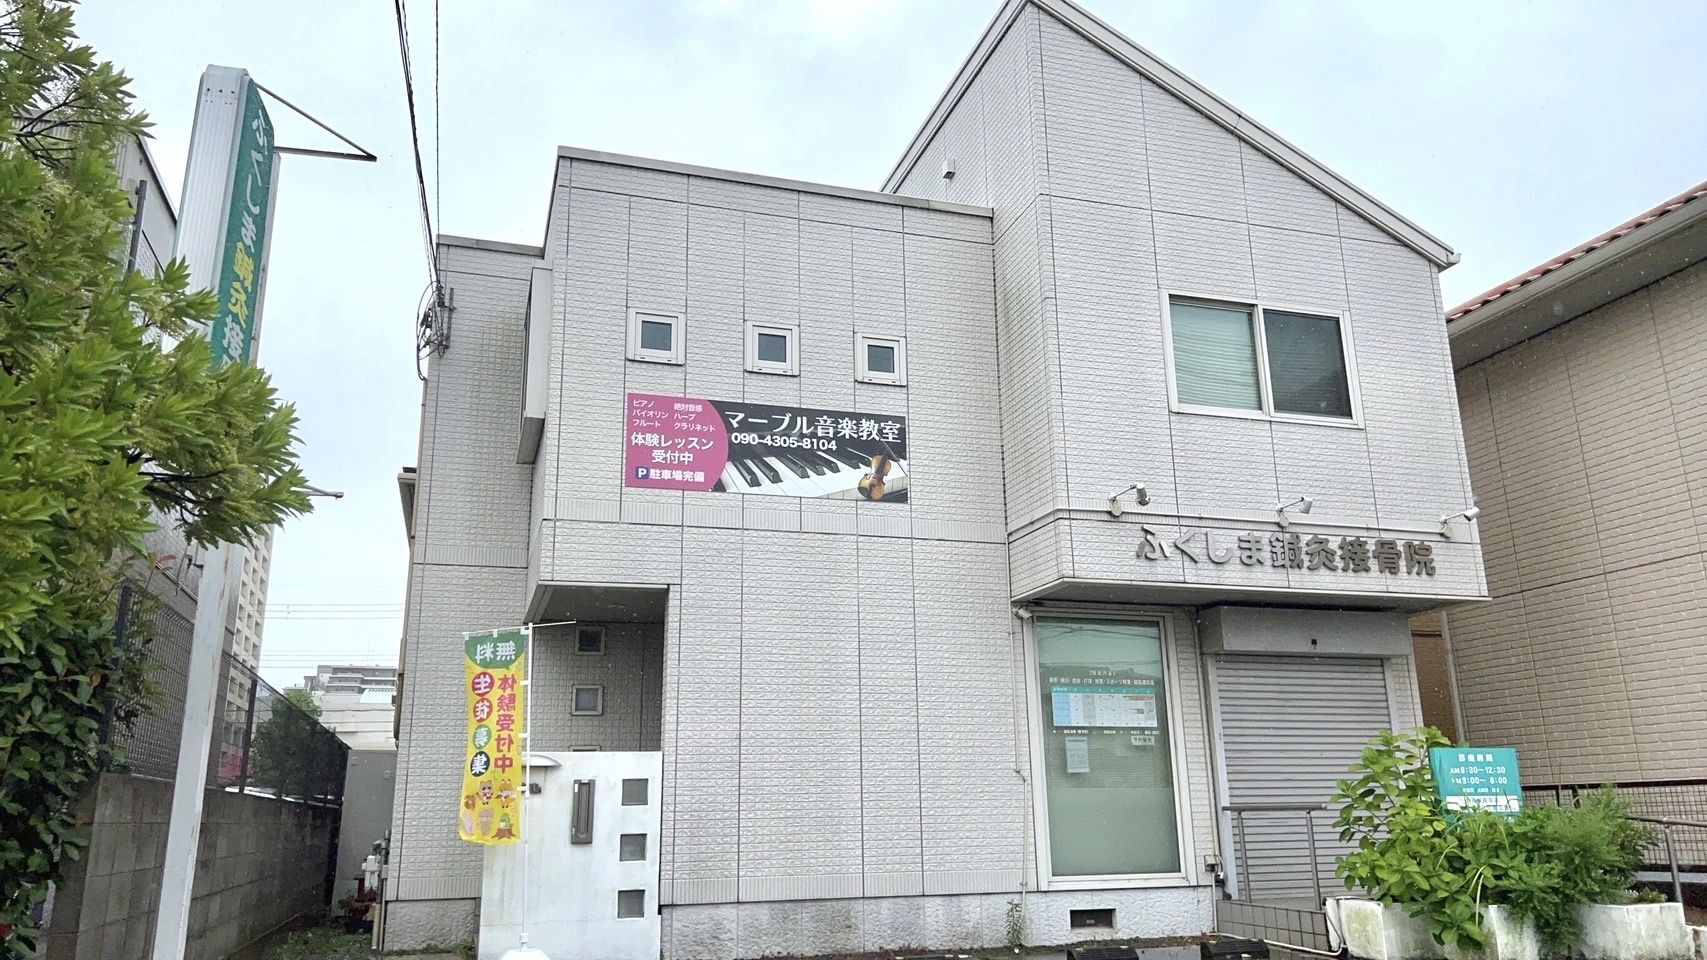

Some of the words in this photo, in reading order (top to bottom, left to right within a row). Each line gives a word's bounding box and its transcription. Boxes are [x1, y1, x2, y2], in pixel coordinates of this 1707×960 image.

[633, 399, 654, 408] ピアノ
[674, 403, 703, 412] 絶対音感
[632, 409, 669, 419] バイオリン
[673, 412, 696, 421] ハープ
[632, 419, 660, 428] フルート
[673, 422, 716, 432] クラリネット
[724, 411, 902, 443] マーブル音楽教室
[631, 432, 714, 450] 体験レッスン
[731, 432, 838, 451] 090-4305-8104
[652, 449, 694, 465] 受付中
[649, 468, 705, 483] 駐車場完備
[1136, 525, 1437, 576] ふくしま鍼灸接骨院
